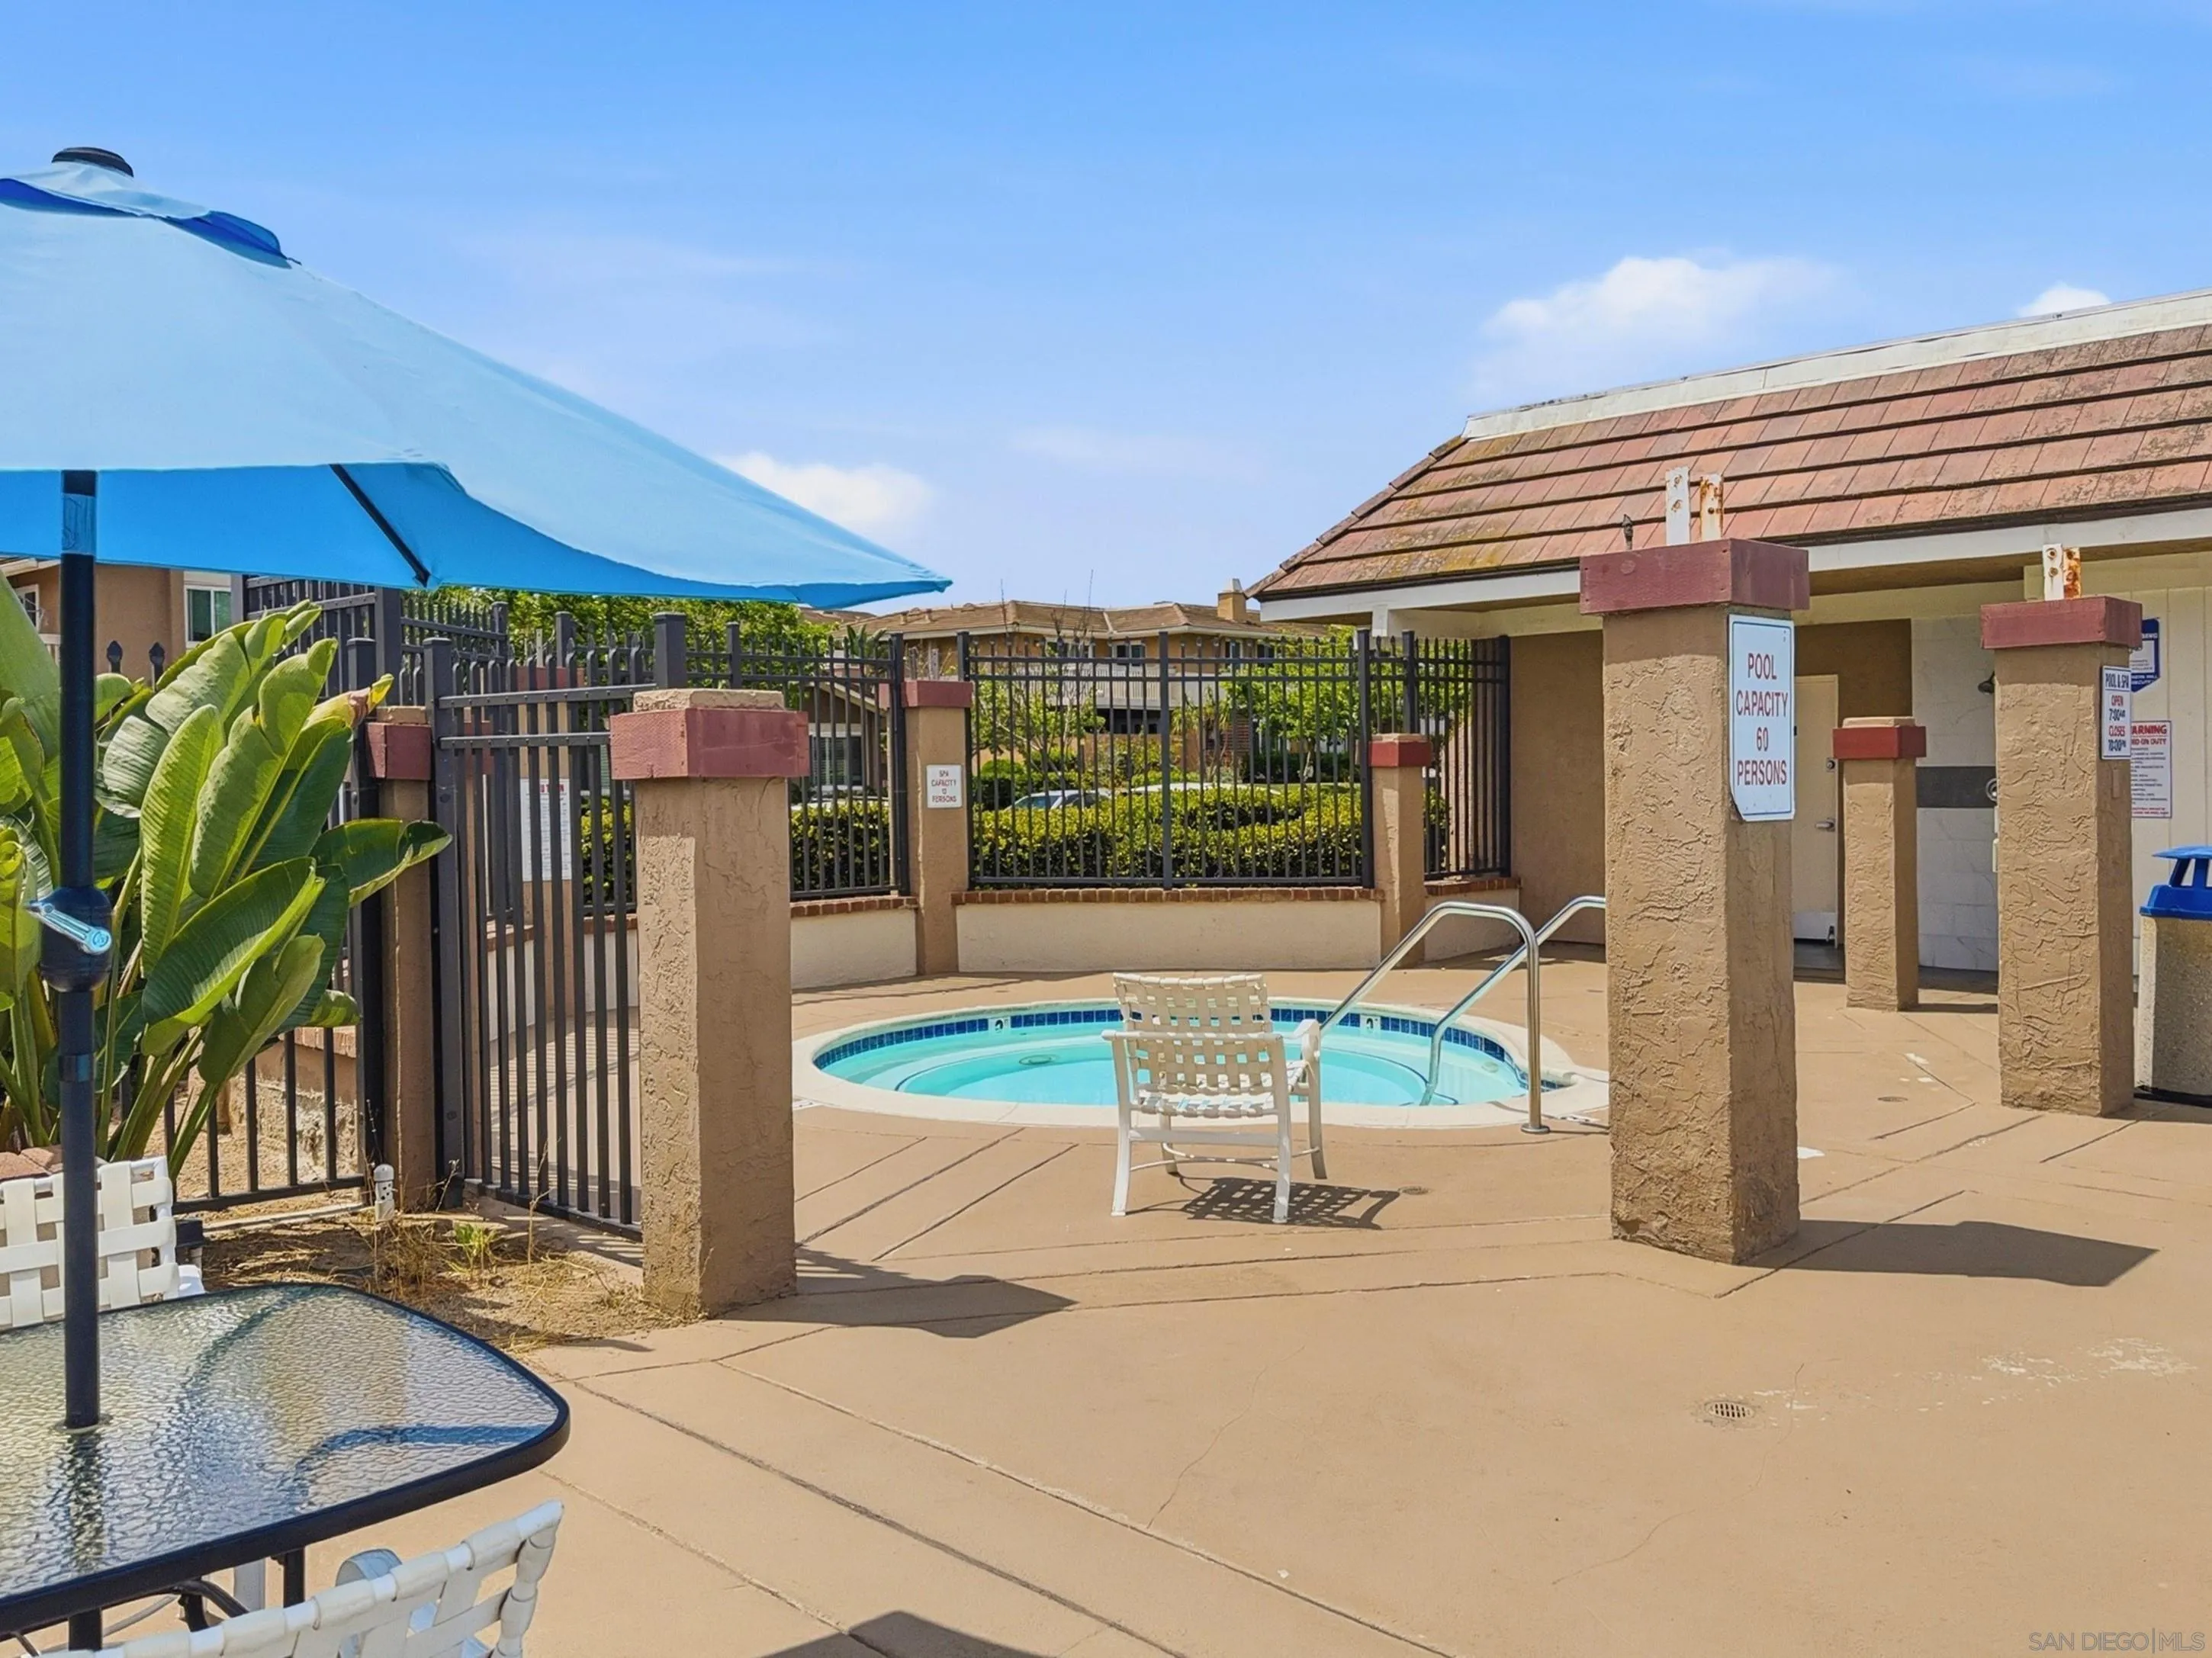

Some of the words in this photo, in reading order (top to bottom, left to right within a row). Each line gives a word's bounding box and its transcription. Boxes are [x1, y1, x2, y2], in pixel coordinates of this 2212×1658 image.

[1747, 653, 1777, 680] POOL
[2105, 673, 2117, 688] POOL
[1736, 689, 1788, 717] CAPACITY
[2111, 694, 2124, 706] OPEN
[1757, 727, 1769, 751] 60
[2109, 725, 2126, 737] CLOSES
[2131, 725, 2167, 734] ARNING
[1737, 760, 1787, 786] PERSONS
